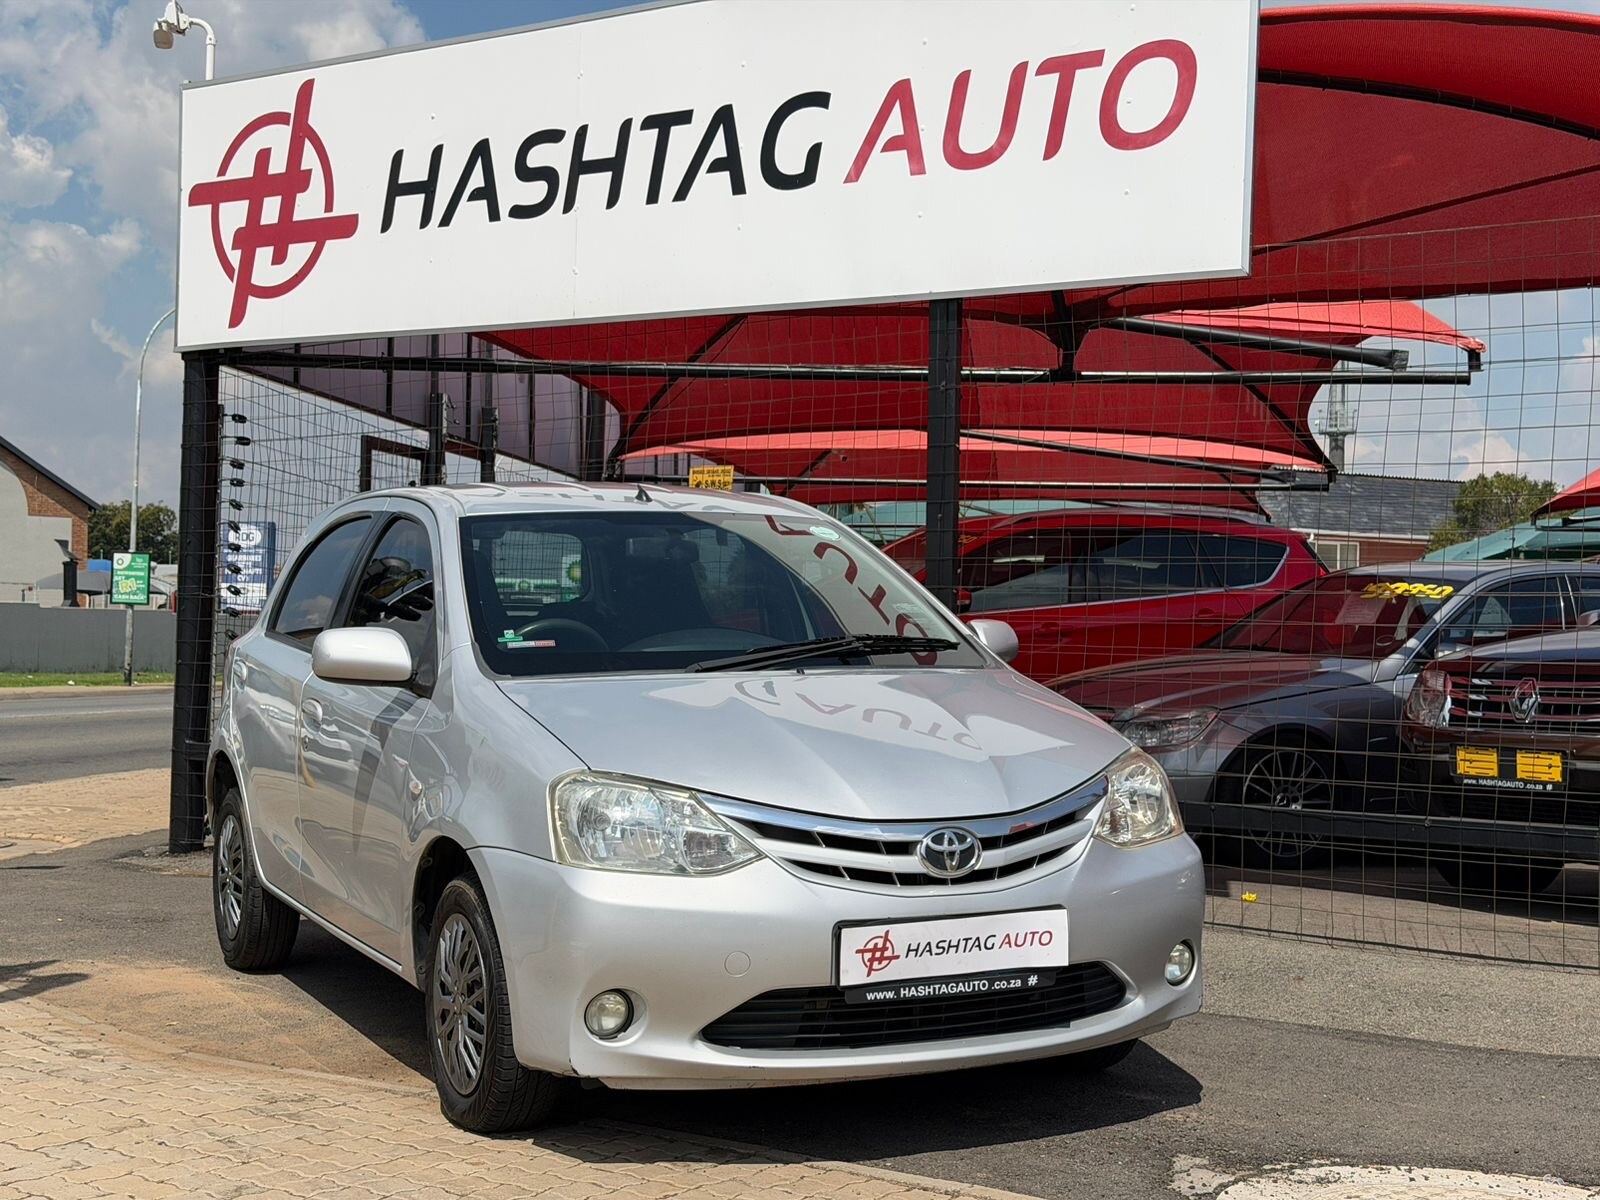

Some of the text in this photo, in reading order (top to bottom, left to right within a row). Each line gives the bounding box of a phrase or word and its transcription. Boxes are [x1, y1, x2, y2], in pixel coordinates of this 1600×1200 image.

[380, 39, 1198, 234] HASHTAG AUTO
[1478, 779, 1524, 789] HASHTAGAUTO
[905, 930, 1053, 959] HASHTAG AUTO
[866, 990, 897, 1001] www.
[900, 979, 989, 998] HASHTAGAUTO
[991, 977, 1022, 990] .co.za
